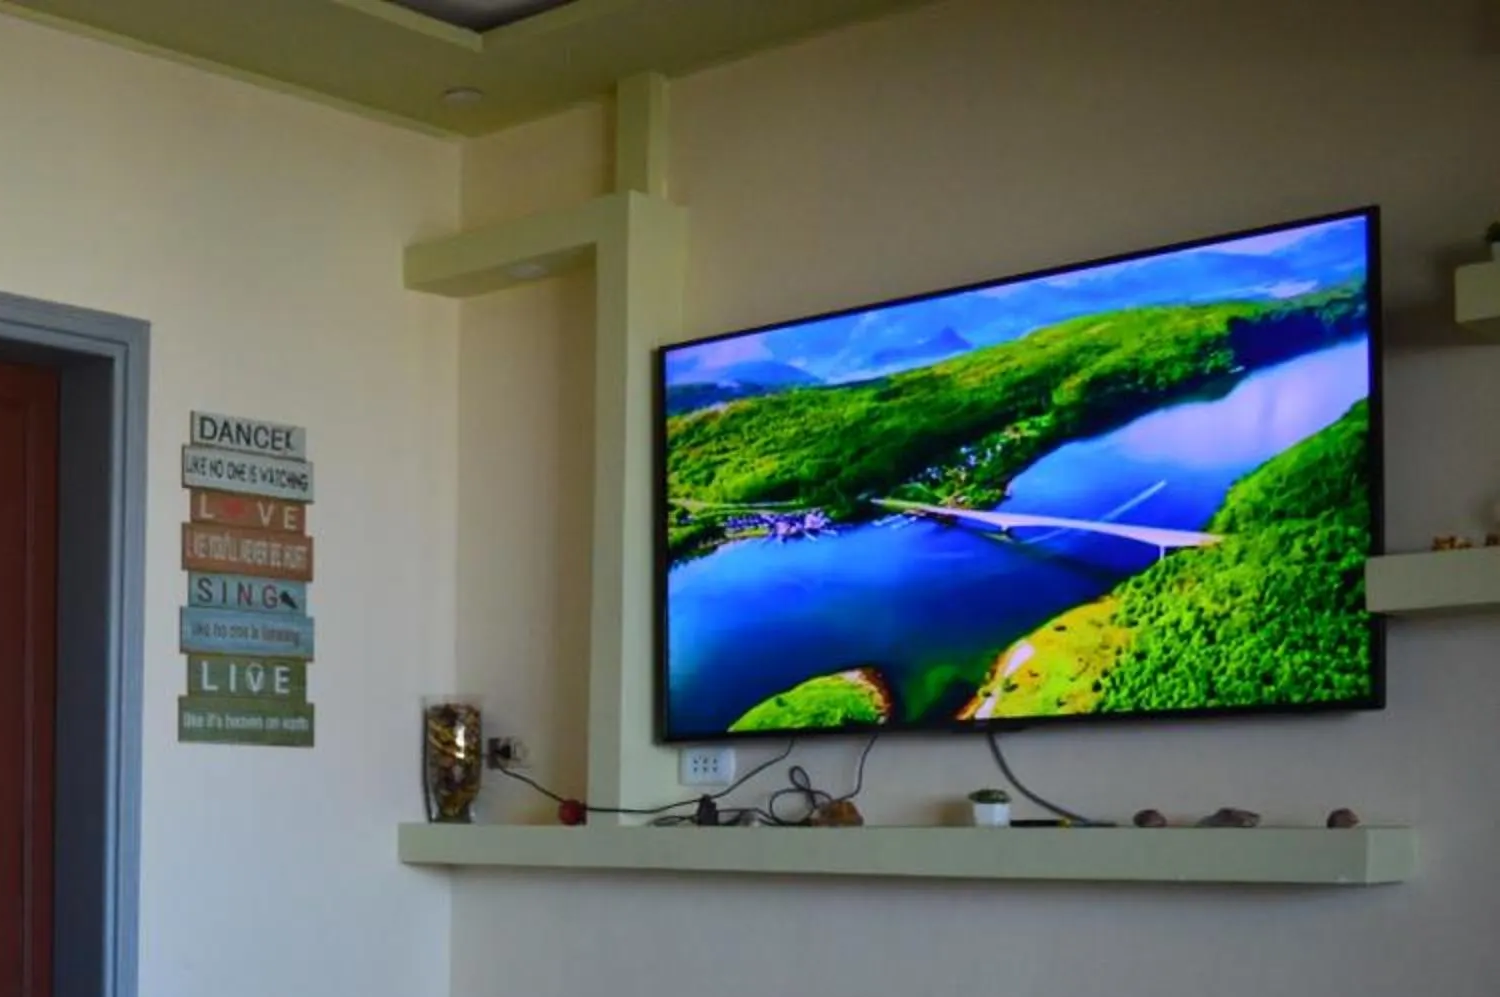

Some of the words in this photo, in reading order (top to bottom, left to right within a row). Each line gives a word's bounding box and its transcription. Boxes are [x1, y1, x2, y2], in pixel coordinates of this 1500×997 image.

[199, 415, 283, 451] DANCE
[185, 455, 208, 477] LIKE
[209, 458, 223, 479] NO
[227, 461, 248, 482] ONE
[260, 466, 309, 493] WATCHING
[200, 493, 298, 530] LVE
[197, 577, 278, 609] SING
[201, 661, 291, 694] LIVE
